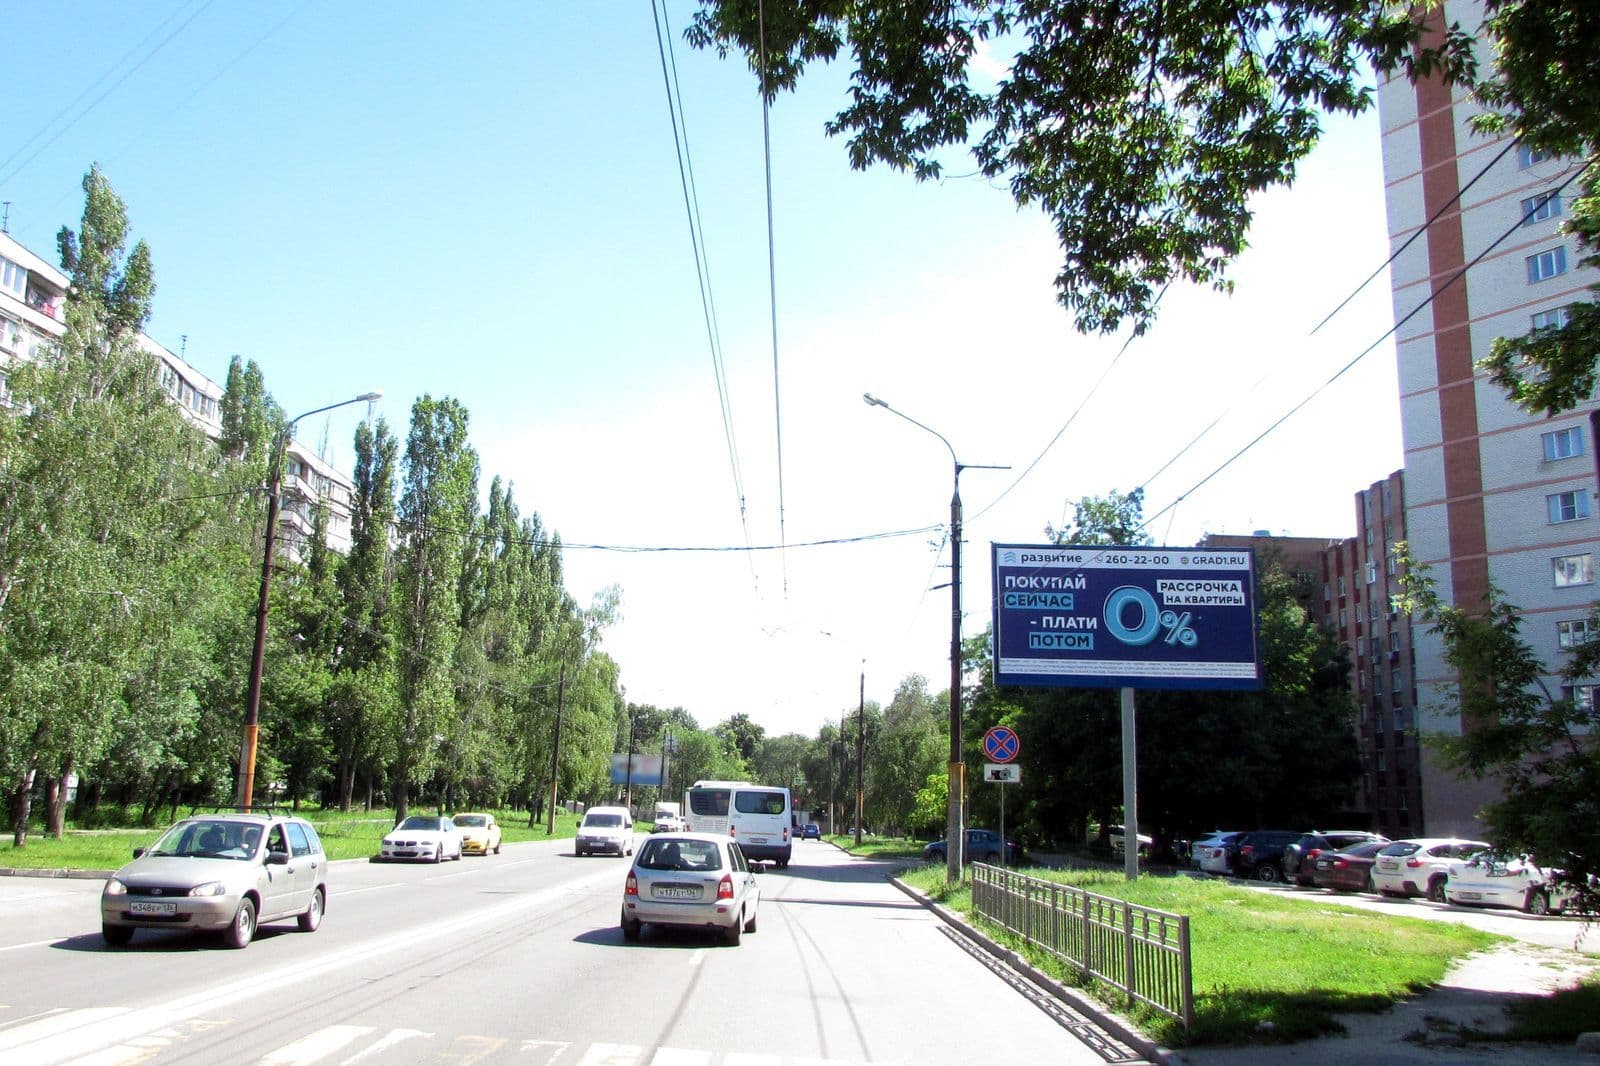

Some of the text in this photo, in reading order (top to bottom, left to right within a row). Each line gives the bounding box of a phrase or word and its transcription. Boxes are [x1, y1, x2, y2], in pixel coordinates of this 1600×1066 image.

[1021, 554, 1082, 564] развитие
[1105, 555, 1169, 565] 260-22-00
[1192, 556, 1245, 566] GRAD1.RU
[1005, 574, 1086, 589] ПОКУПАЙ
[1160, 582, 1238, 593] РАССРОЧКА
[1166, 595, 1242, 605] НА КВАРТИРЫ
[1042, 616, 1097, 629] ПЛАТИ
[1030, 634, 1090, 647] ПОТОМ
